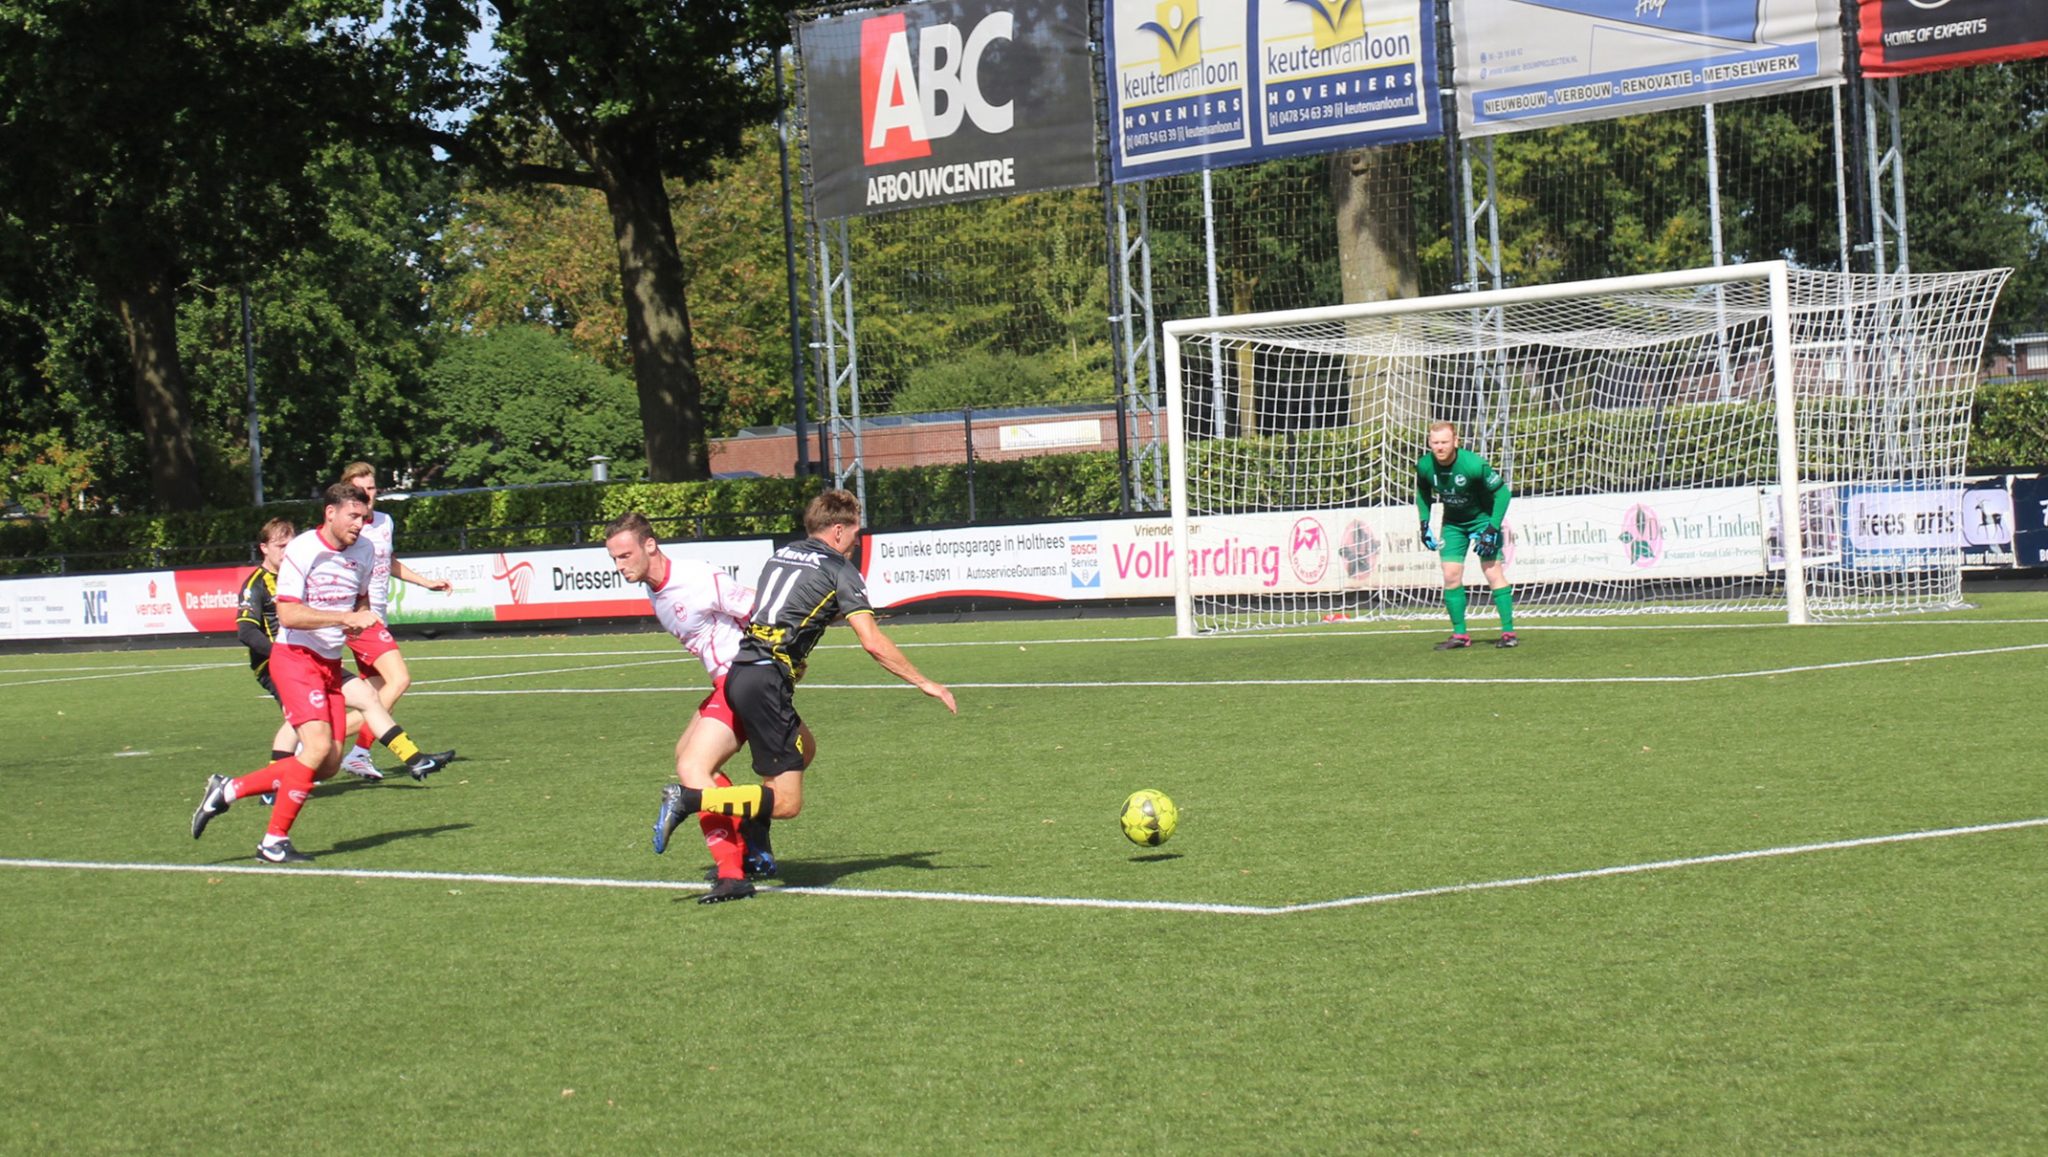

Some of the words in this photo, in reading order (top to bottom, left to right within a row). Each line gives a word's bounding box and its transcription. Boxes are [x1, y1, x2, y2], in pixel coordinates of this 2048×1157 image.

[1884, 30, 1915, 47] HOME
[1917, 27, 1933, 42] OF
[1934, 18, 1987, 40] EXPERTS
[1267, 31, 1411, 75] keutenvanloon
[869, 11, 1014, 149] ABC
[1123, 58, 1239, 100] keutenvanloon
[1268, 72, 1413, 106] HOVENIERS
[1483, 92, 1548, 115] NIEUWBOUW
[1555, 83, 1612, 103] VERBOUW
[1621, 71, 1692, 94] RENOVATIE
[1703, 55, 1799, 83] METSELWERK
[1125, 98, 1240, 129] HOVENIERS
[1279, 109, 1298, 124] 0478
[1300, 108, 1310, 121] 54
[1311, 106, 1321, 120] 63
[1322, 105, 1333, 118] 39
[1344, 93, 1414, 115] keutenvanloon.nl
[1150, 131, 1158, 144] 54
[1168, 128, 1177, 142] 39
[866, 158, 1015, 206] AFBOUWCENTRE
[1134, 524, 1174, 537] Vriende
[1523, 524, 1553, 546] Vier
[1557, 521, 1607, 545] Linden
[1648, 517, 1667, 541] De
[1672, 516, 1703, 540] Vier
[1707, 513, 1761, 538] Linden
[897, 540, 932, 557] unieke
[935, 538, 1001, 558] dorpsgarage
[1004, 534, 1014, 551] in
[1017, 532, 1065, 551] Holthees
[1071, 543, 1097, 555] BOSCH
[894, 568, 951, 584] 0478-745091
[966, 561, 1068, 579] AutoserviceGoumans.nl
[1071, 557, 1098, 568] Service
[552, 566, 621, 591] Driessen
[82, 590, 108, 624] NC
[185, 592, 199, 609] De
[200, 589, 239, 608] sterkste
[750, 566, 802, 624] 11
